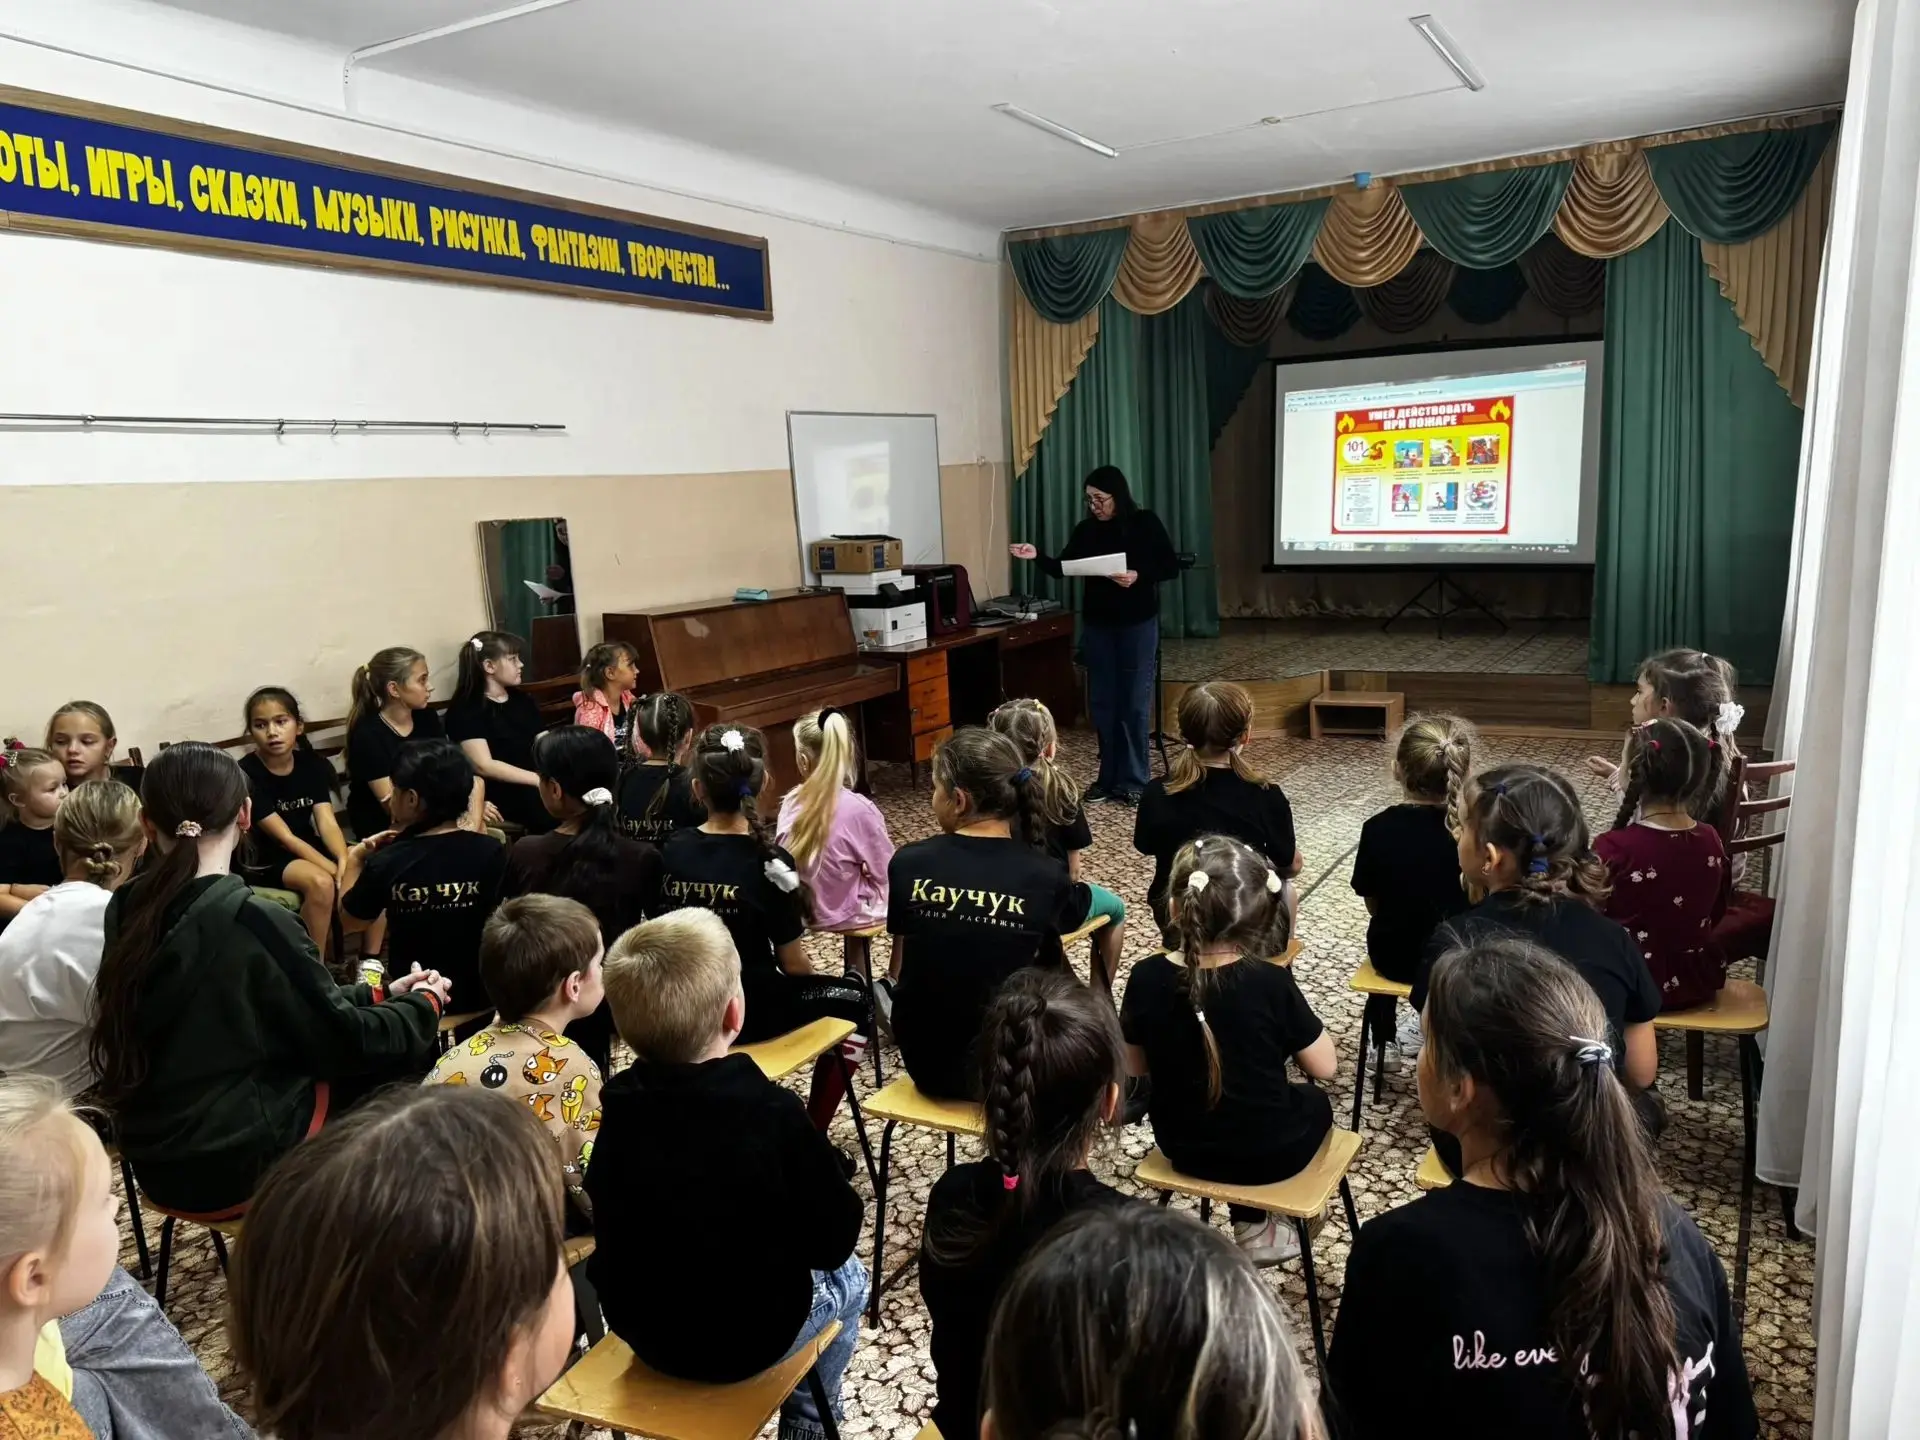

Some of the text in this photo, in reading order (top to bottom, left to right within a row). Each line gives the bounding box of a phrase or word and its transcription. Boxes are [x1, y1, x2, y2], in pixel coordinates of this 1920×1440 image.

[85, 145, 184, 212] ИГРЫ,
[189, 164, 307, 229] СКАЗКИ,
[313, 185, 425, 247] МУЗЫКИ,
[429, 205, 526, 261] РИСУНКА,
[531, 224, 625, 276] ФАНТАЗИИ,
[1368, 402, 1475, 421] УМЕЙ ДЕЙСТВОВАТЬ
[1383, 415, 1457, 431] ПРИ ПОЖАРЕ
[1347, 440, 1364, 452] 101
[391, 880, 480, 904] Каучук
[909, 878, 1026, 916] Каучук
[1452, 1330, 1508, 1370] like
